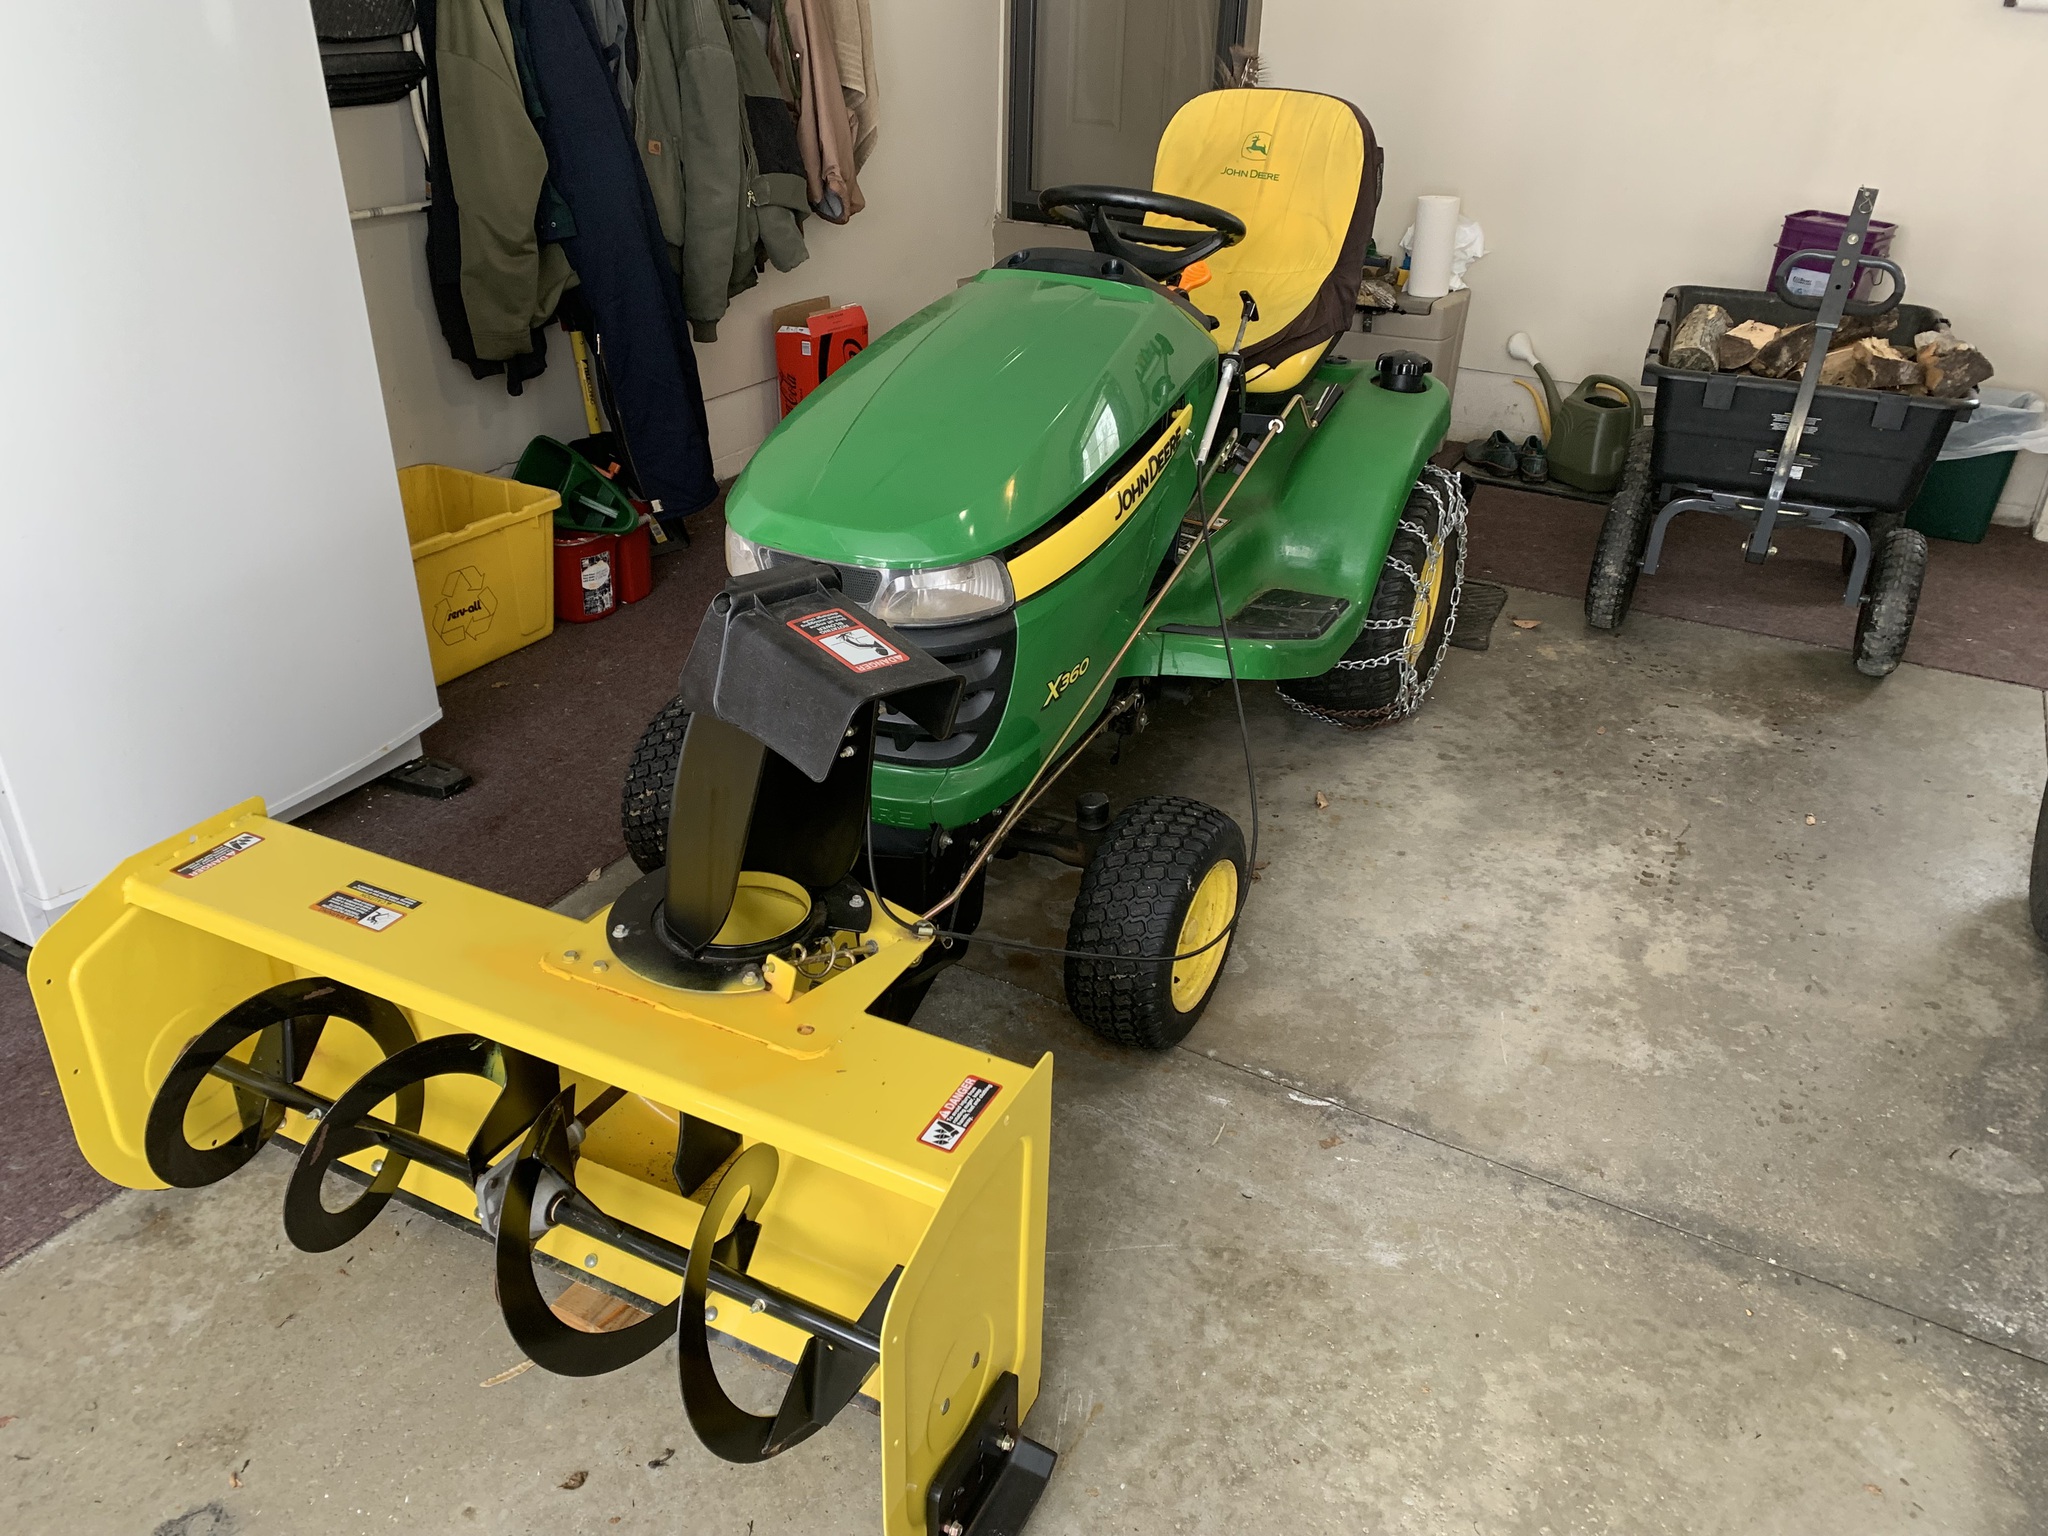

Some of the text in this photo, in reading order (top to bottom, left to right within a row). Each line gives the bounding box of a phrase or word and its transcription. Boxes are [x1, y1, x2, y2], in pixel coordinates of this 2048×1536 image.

[1220, 166, 1280, 182] JOHN DEERE
[1115, 426, 1182, 520] JOHN DEERE
[447, 600, 482, 622] serv-all
[854, 656, 898, 671] DANGER
[1042, 656, 1090, 708] X360
[187, 854, 228, 876] DANGER
[944, 1077, 977, 1110] DANGER
